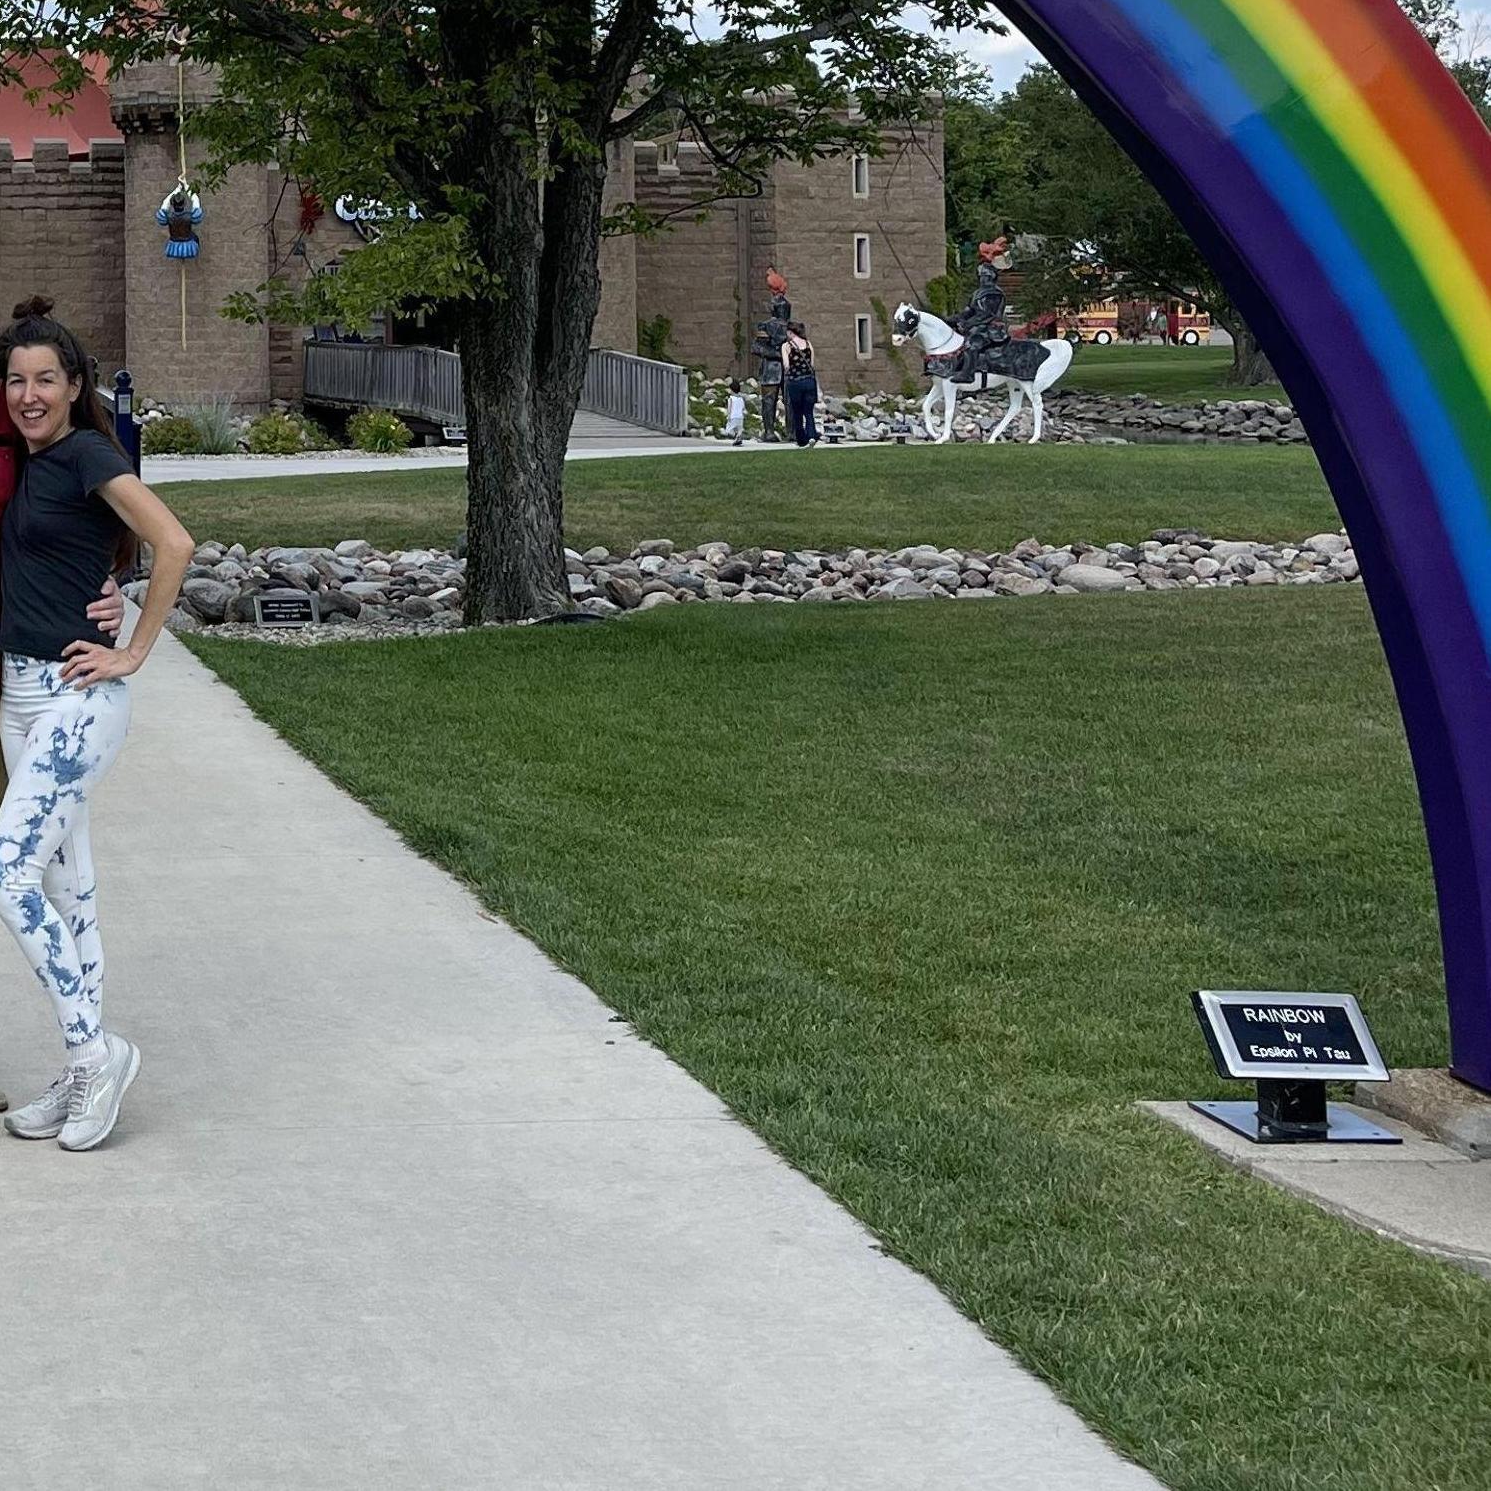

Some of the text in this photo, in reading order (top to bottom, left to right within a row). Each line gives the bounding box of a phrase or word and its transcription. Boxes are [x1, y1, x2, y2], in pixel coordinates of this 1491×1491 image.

[1243, 1008, 1326, 1024] RAINBOW
[1283, 1029, 1302, 1044] by
[1250, 1045, 1352, 1060] Epsilon Pi Tau
